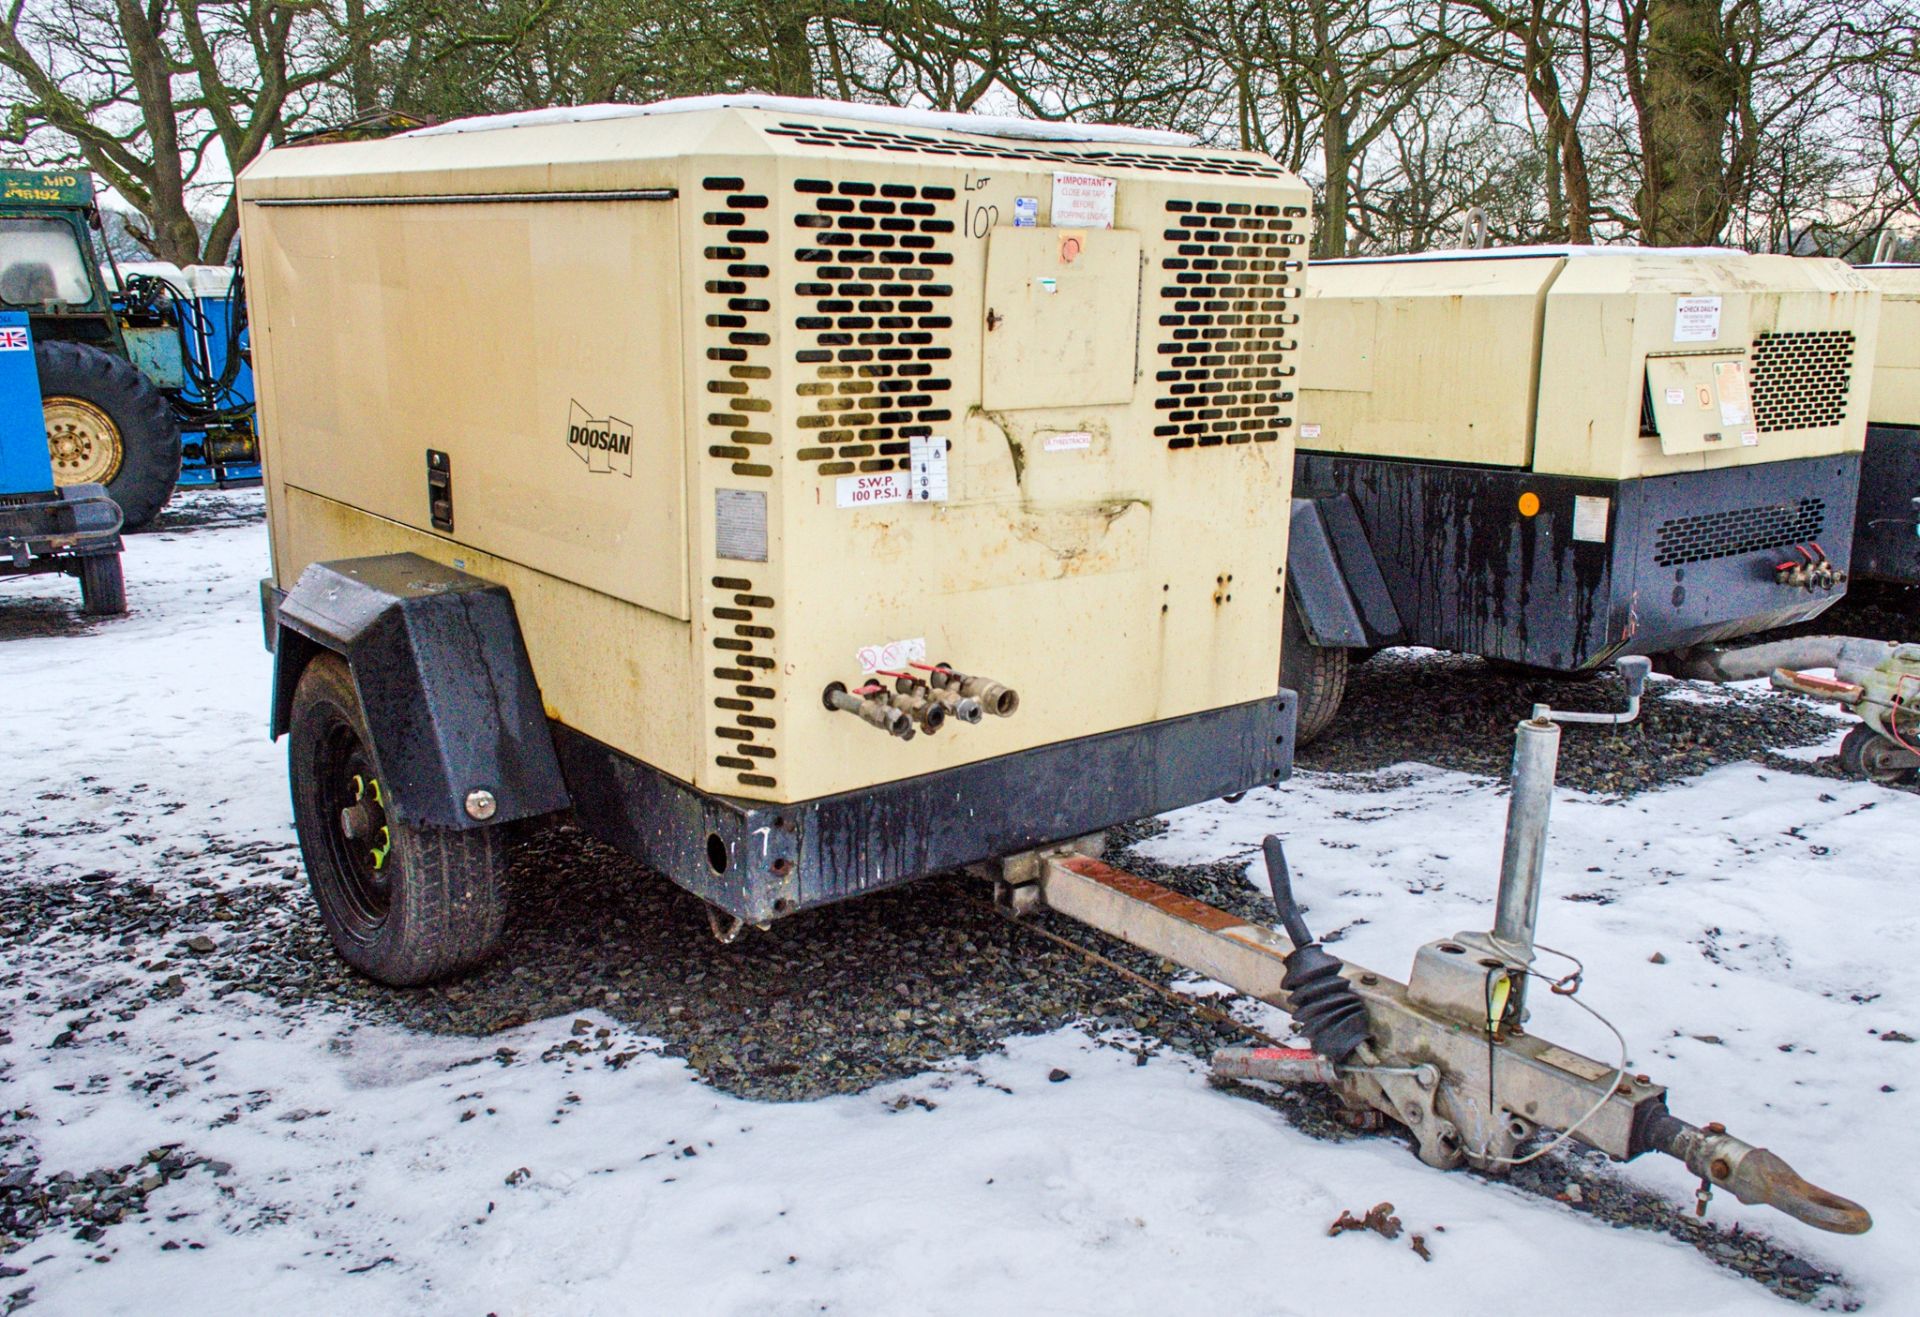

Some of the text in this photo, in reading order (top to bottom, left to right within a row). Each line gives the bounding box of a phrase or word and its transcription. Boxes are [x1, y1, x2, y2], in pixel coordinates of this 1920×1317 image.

[1063, 176, 1106, 187] IMPORTANT
[1061, 187, 1106, 198] CLOSE AIR TAPS
[1072, 199, 1095, 209] BEFORE
[1057, 210, 1086, 220] STOPPING
[569, 425, 631, 455] DOOSAN
[858, 476, 895, 489] S.W.P.
[852, 489, 902, 502] 100 P.S.I.
